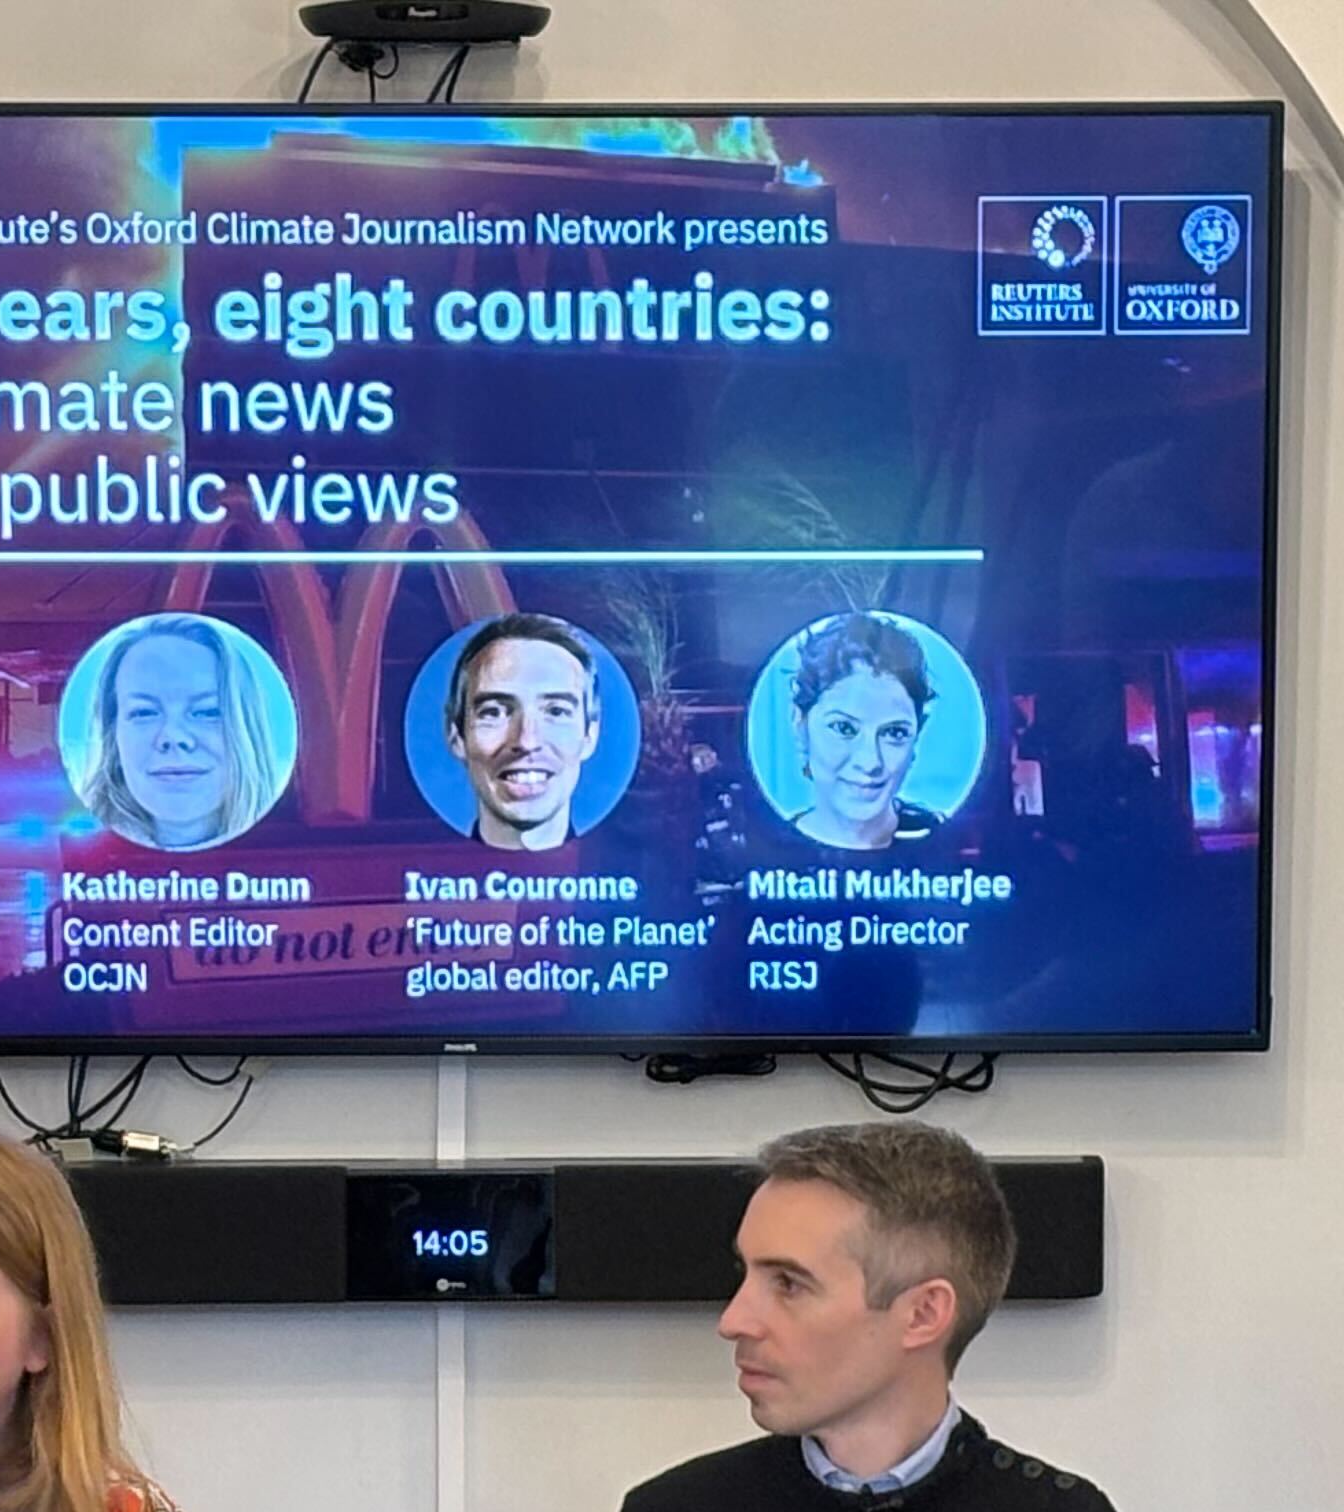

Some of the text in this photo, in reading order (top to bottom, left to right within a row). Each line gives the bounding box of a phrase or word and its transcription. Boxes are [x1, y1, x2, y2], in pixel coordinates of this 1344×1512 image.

[86, 211, 197, 243] Oxford
[207, 211, 334, 243] Climate
[343, 211, 526, 244] Journalism
[535, 211, 676, 245] Network
[685, 215, 829, 250] presents
[991, 283, 1083, 301] REUTERS
[214, 272, 414, 359] eight
[434, 272, 830, 342] countries:
[991, 303, 1095, 322] INSTITUTE
[1125, 299, 1240, 321] OXFORD
[200, 379, 395, 432] news
[0, 455, 227, 540] public
[247, 455, 459, 524] views
[63, 870, 311, 901] Katherine Dunn
[405, 871, 638, 900] Ivan Couronne
[748, 868, 1012, 905] Mitali Mukherjee
[63, 917, 279, 947] Content Editor
[274, 922, 355, 964] not
[519, 916, 550, 946] of
[555, 917, 605, 946] the
[747, 915, 970, 951] Acting Director
[64, 962, 148, 992] OCJN
[406, 961, 669, 997] global editor, AFP
[749, 961, 818, 990] RISJ
[412, 1230, 489, 1257] 14:05
